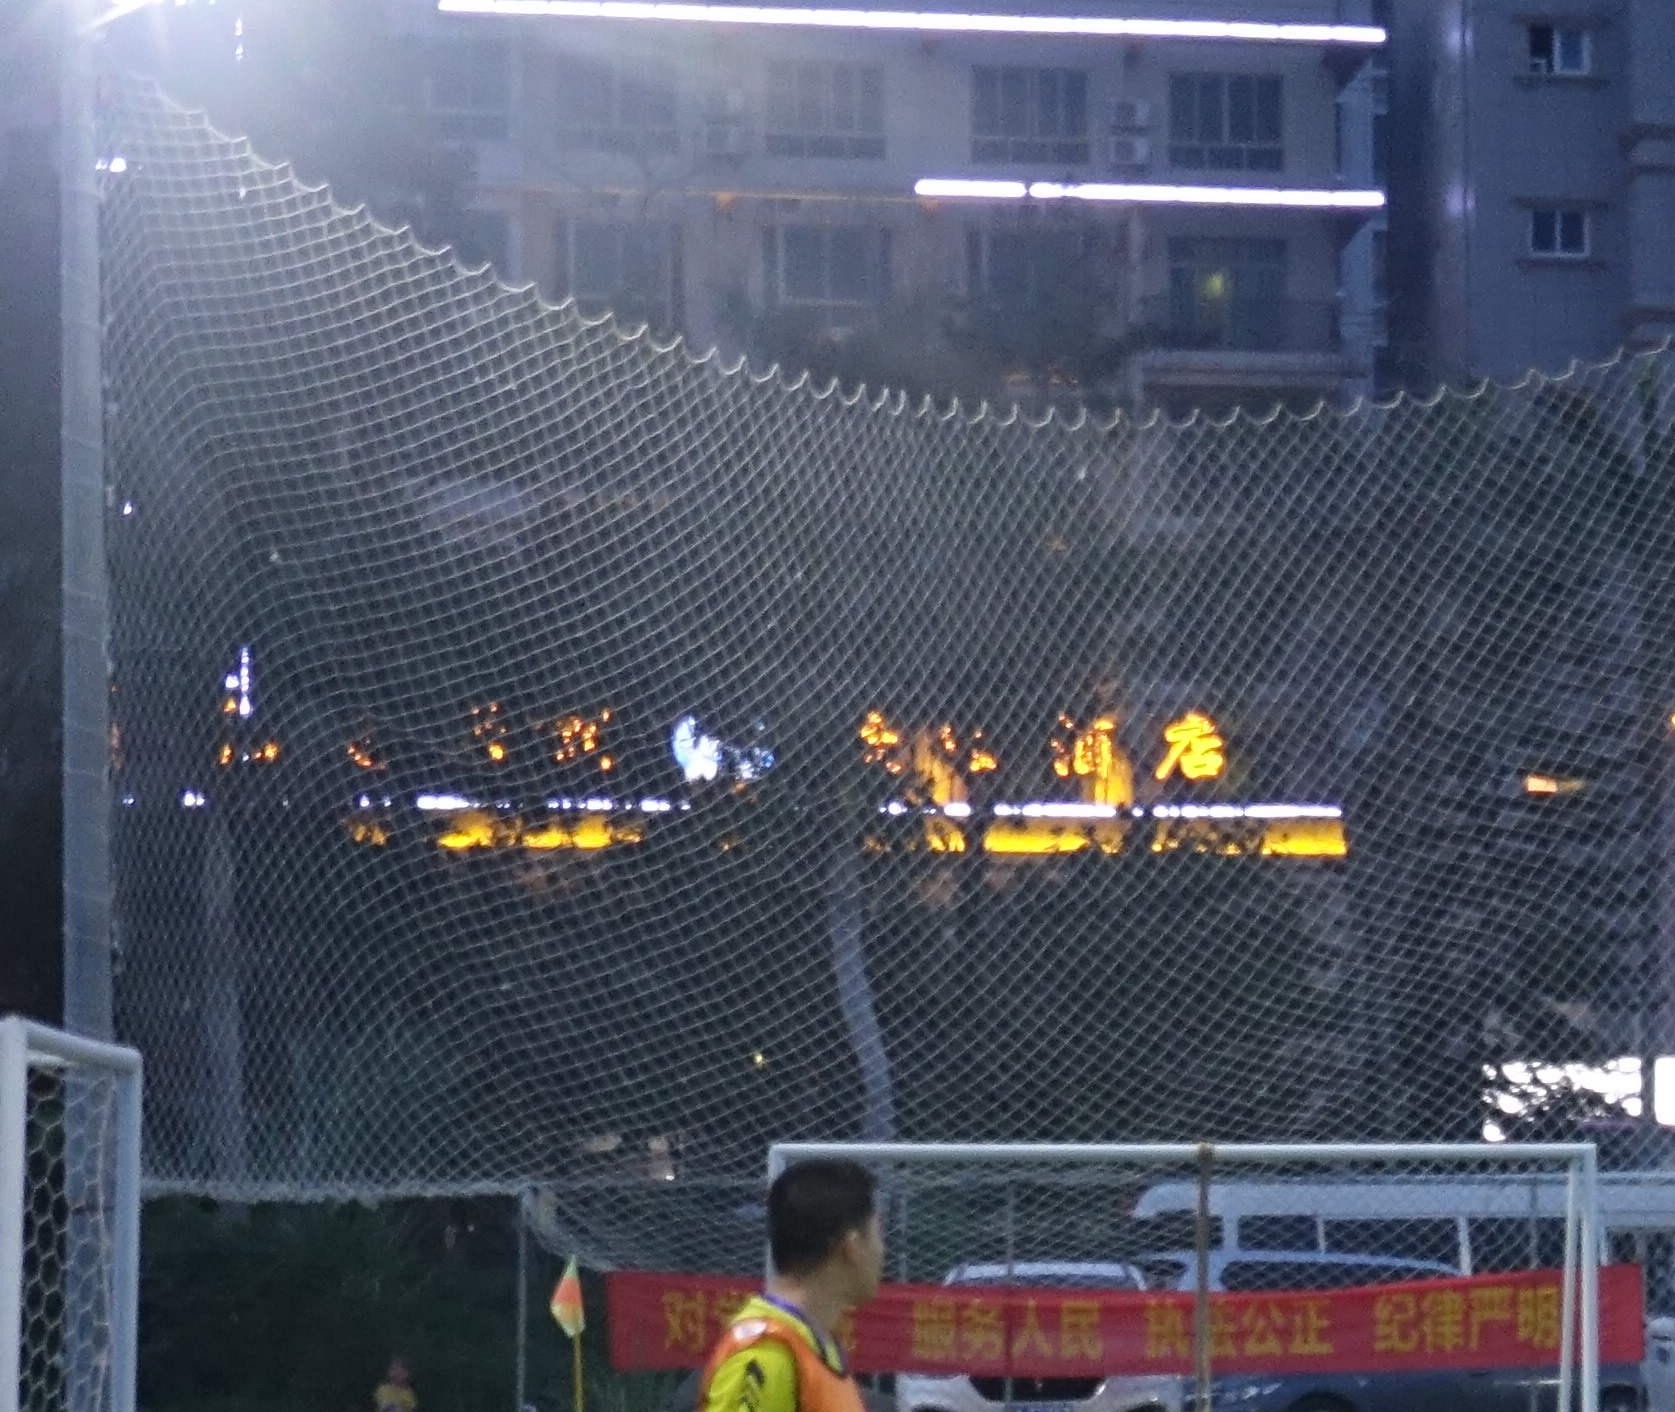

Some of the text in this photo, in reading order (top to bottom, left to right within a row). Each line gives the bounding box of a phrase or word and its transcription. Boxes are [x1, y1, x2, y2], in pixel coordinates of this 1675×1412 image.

[912, 1300, 1105, 1359] 服务人民
[1372, 1285, 1562, 1352] 纪律严明
